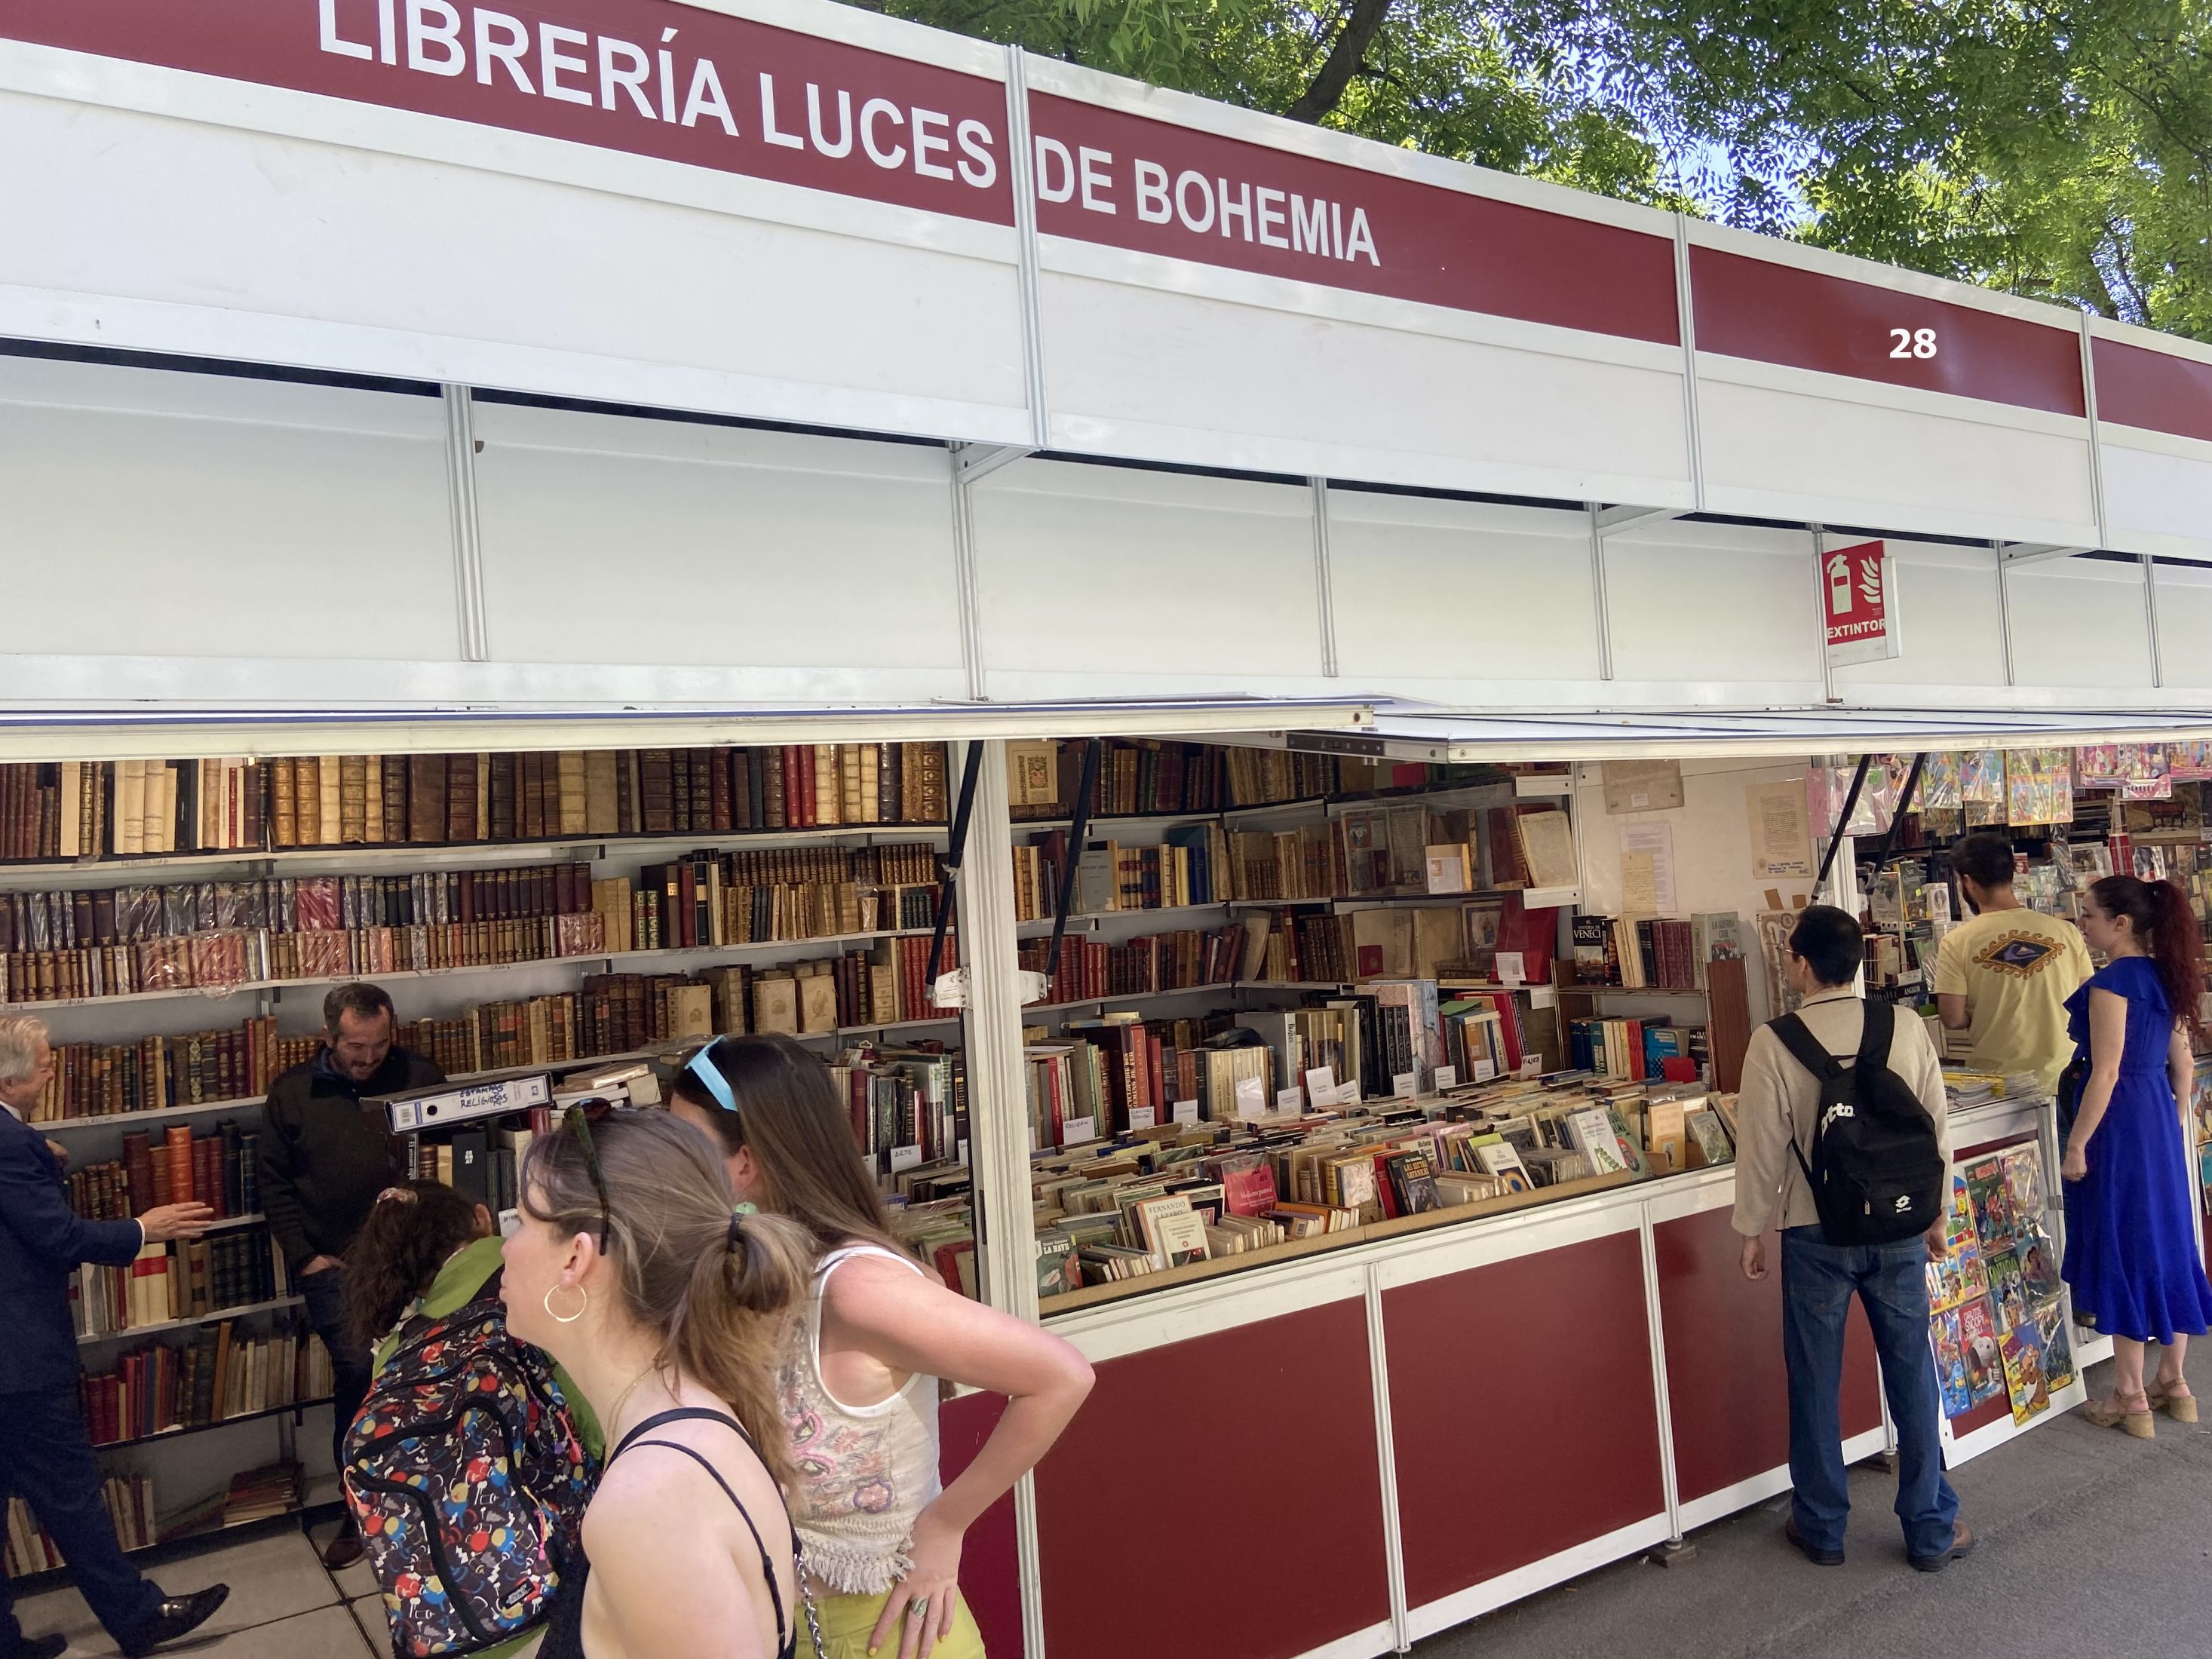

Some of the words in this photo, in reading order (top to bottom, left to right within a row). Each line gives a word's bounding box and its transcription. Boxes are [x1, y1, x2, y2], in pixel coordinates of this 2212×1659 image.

[318, 0, 740, 137] LIBRERÍA
[759, 72, 997, 189] LUCES
[1035, 134, 1117, 216] DE
[1134, 158, 1381, 267] BOHEMIA
[1888, 327, 1937, 359] 28
[1827, 618, 1885, 639] EXTINTOR
[1287, 1023, 1296, 1044] BEATLES
[894, 1148, 913, 1158] ARTE
[1148, 1200, 1186, 1215] FERNANDO
[1964, 1314, 1985, 1332] SNOOPY
